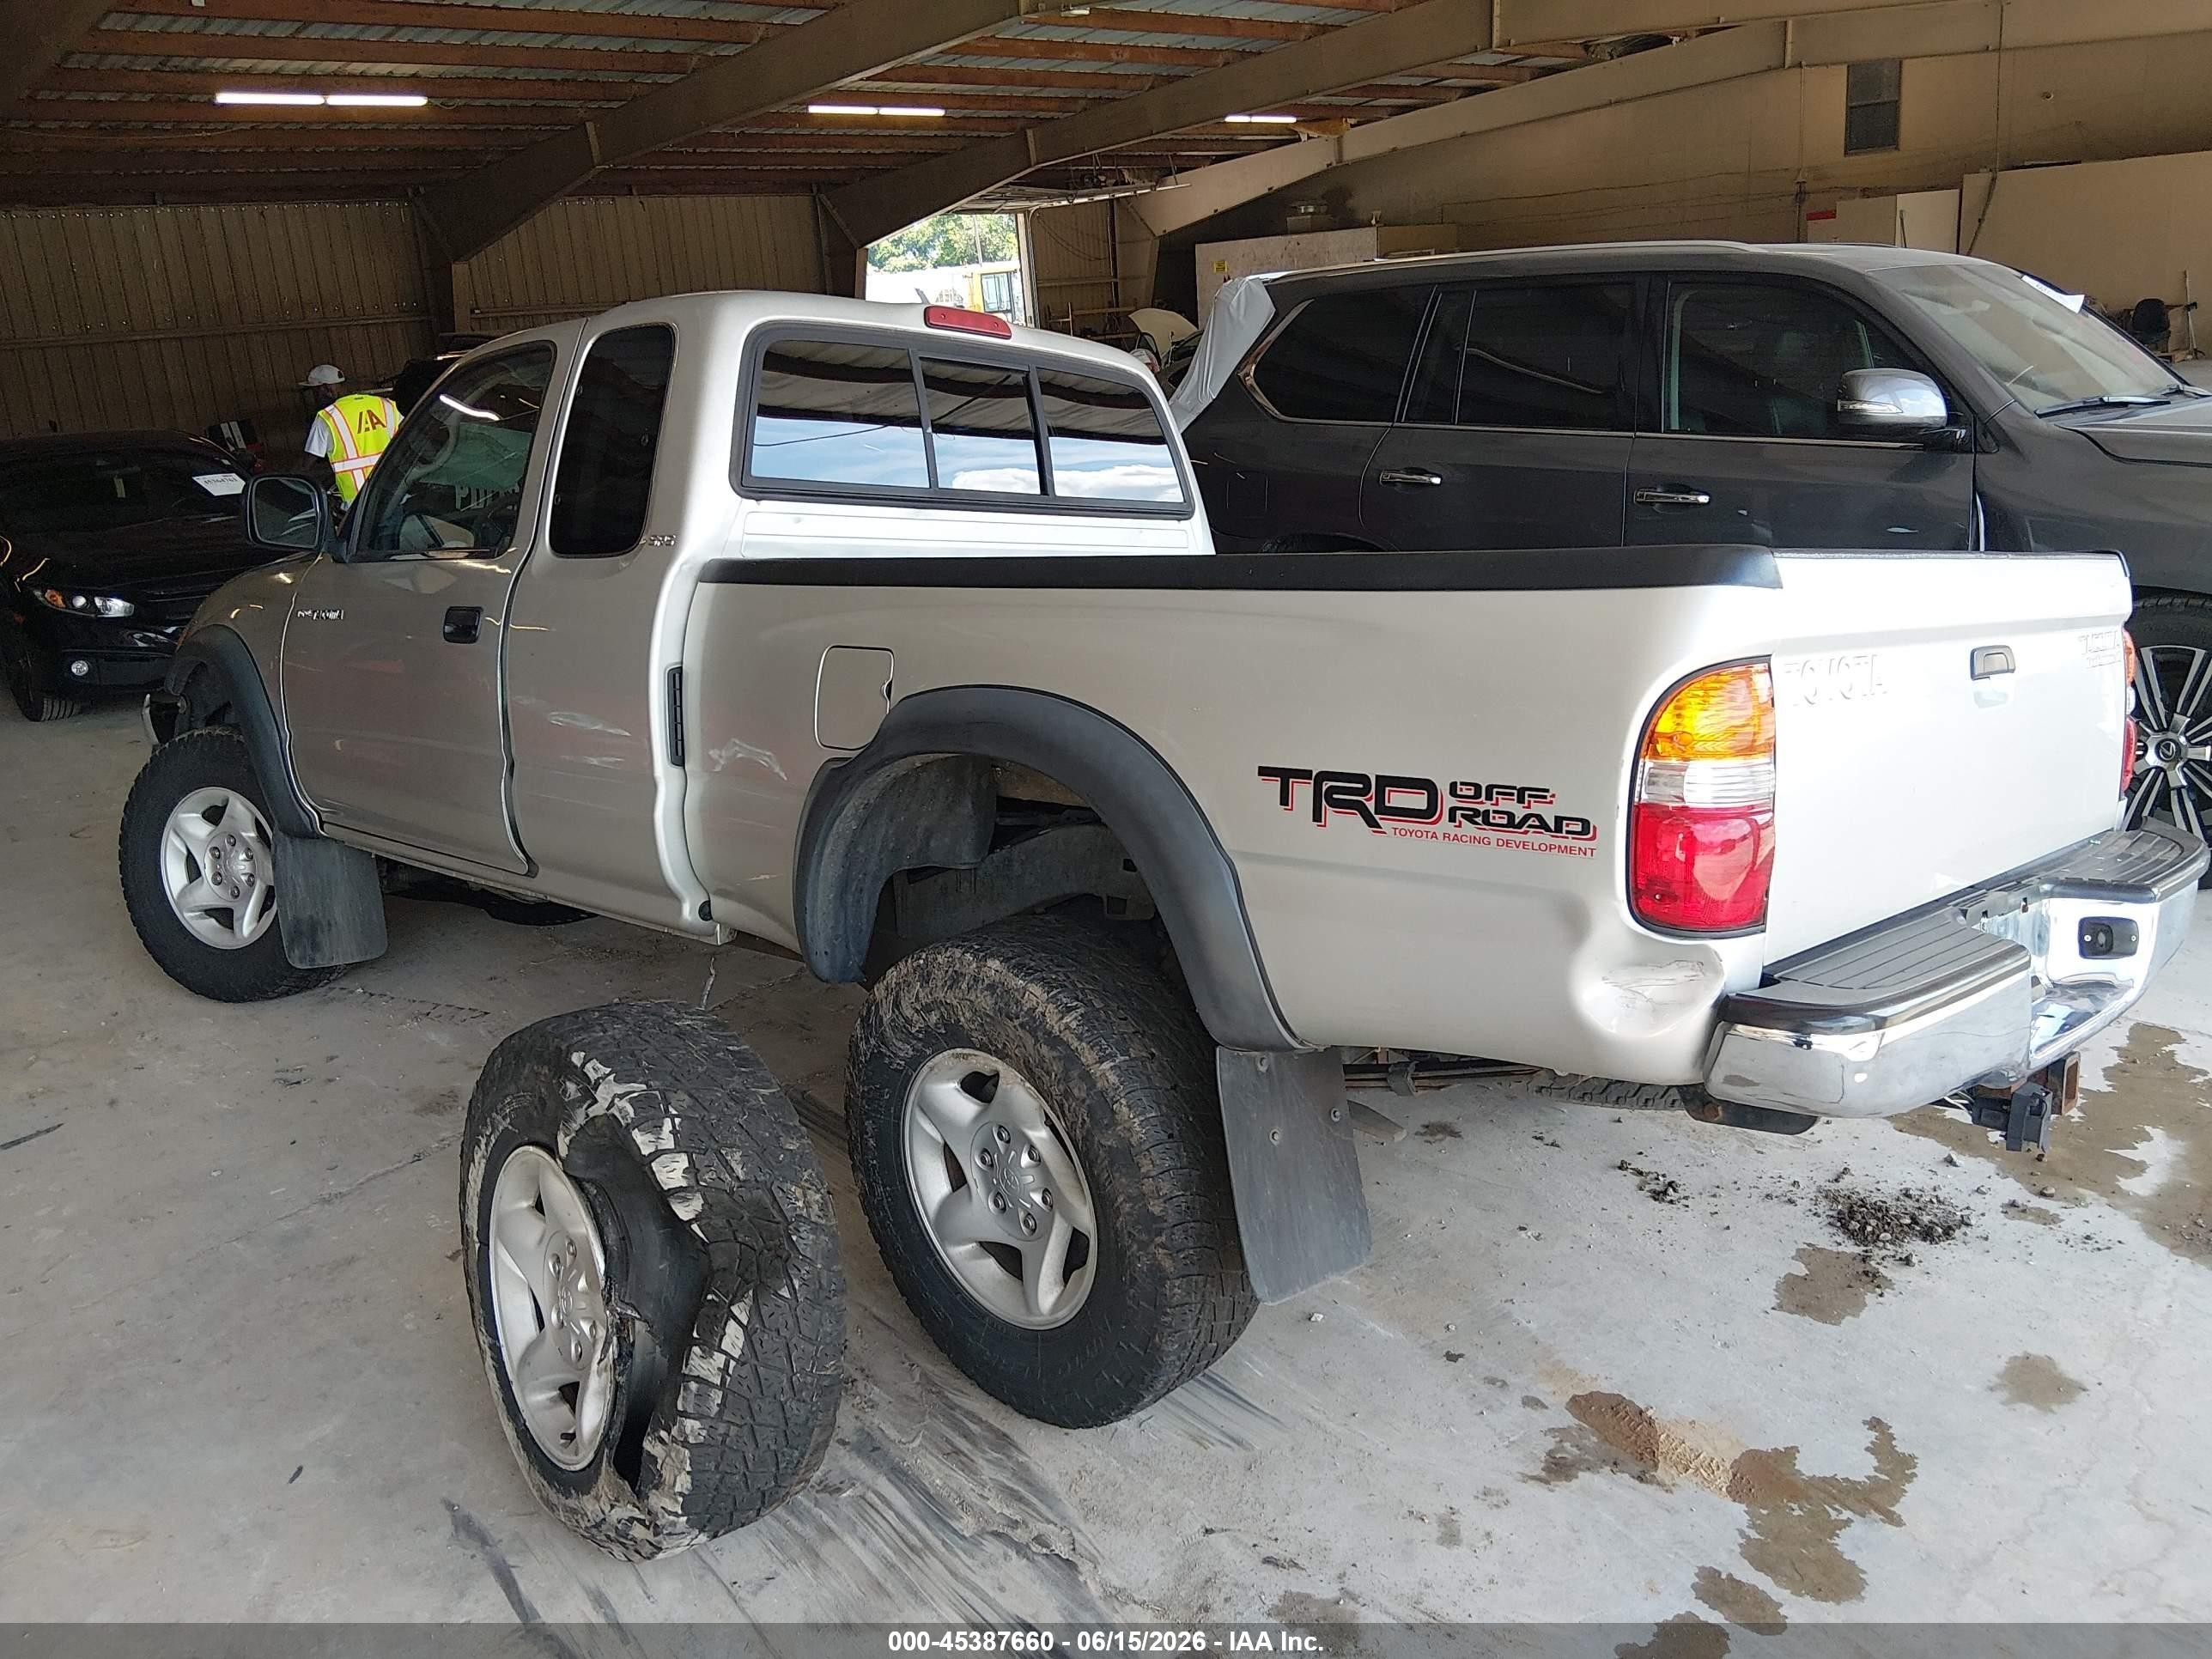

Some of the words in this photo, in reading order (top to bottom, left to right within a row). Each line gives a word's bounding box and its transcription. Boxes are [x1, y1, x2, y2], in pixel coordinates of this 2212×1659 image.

[1257, 765, 1443, 834] TRD
[1449, 781, 1556, 809] OFF
[1448, 805, 1597, 842] ROAD
[1391, 826, 1439, 841] TOYOTA
[1442, 831, 1492, 846] RACING
[1496, 837, 1597, 858] DEVELOPMENT
